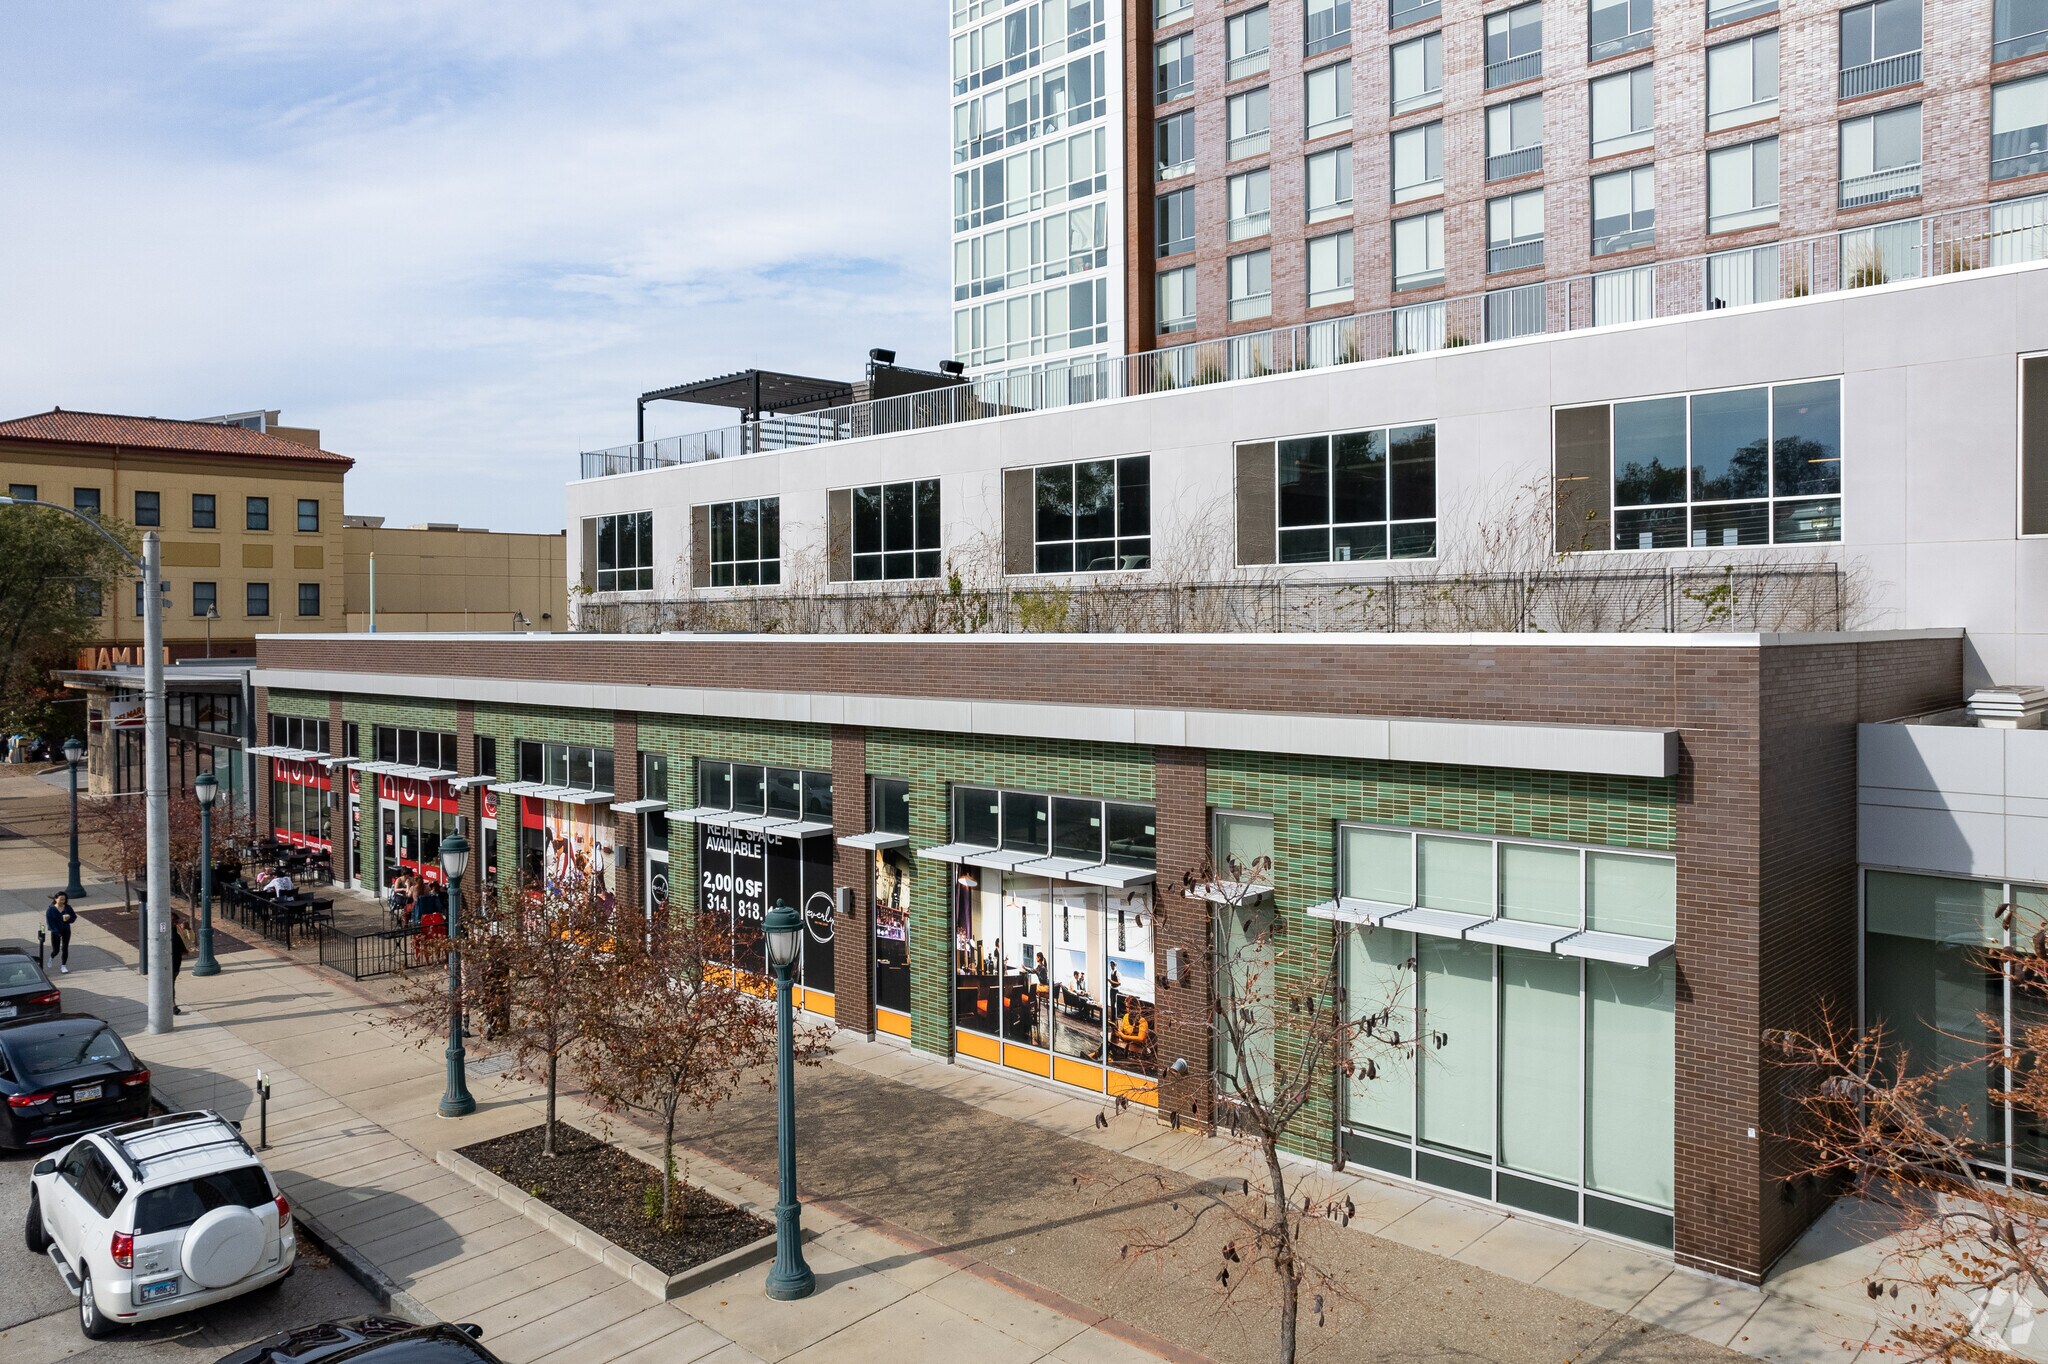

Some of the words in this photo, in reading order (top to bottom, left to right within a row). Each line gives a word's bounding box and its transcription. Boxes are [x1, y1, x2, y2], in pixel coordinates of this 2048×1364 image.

[707, 824, 743, 839] RETAIL
[746, 830, 783, 845] SPACE
[706, 836, 762, 859] AVAILABLE
[745, 879, 763, 898] SF
